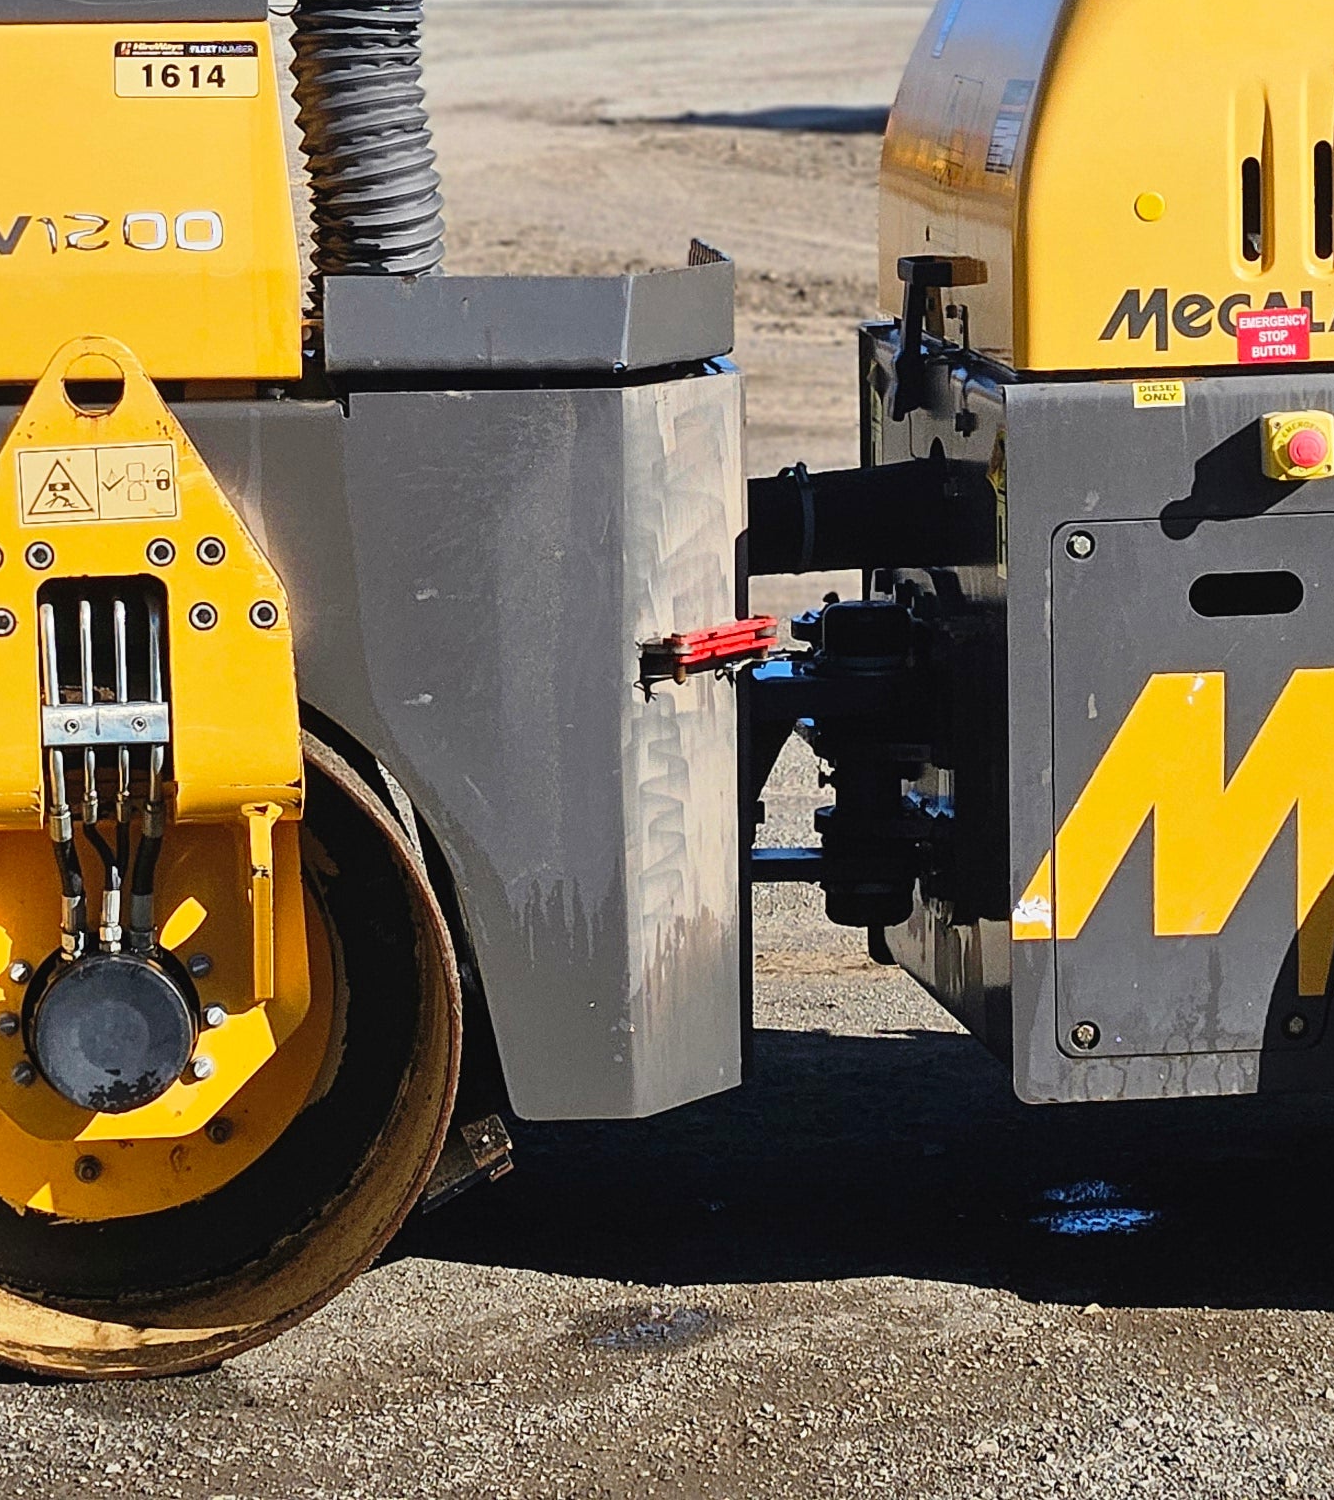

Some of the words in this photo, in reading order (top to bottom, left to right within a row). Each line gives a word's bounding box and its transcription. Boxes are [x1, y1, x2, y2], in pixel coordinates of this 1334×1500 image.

[189, 45, 218, 54] FLEET
[218, 45, 254, 54] NUMBER
[142, 63, 226, 88] 1614
[1239, 314, 1307, 328] EMERGENCY
[1259, 329, 1289, 343] STOP
[1251, 344, 1297, 358] BUTTON
[1138, 384, 1180, 393] DIESEL
[1142, 393, 1177, 402] ONLY
